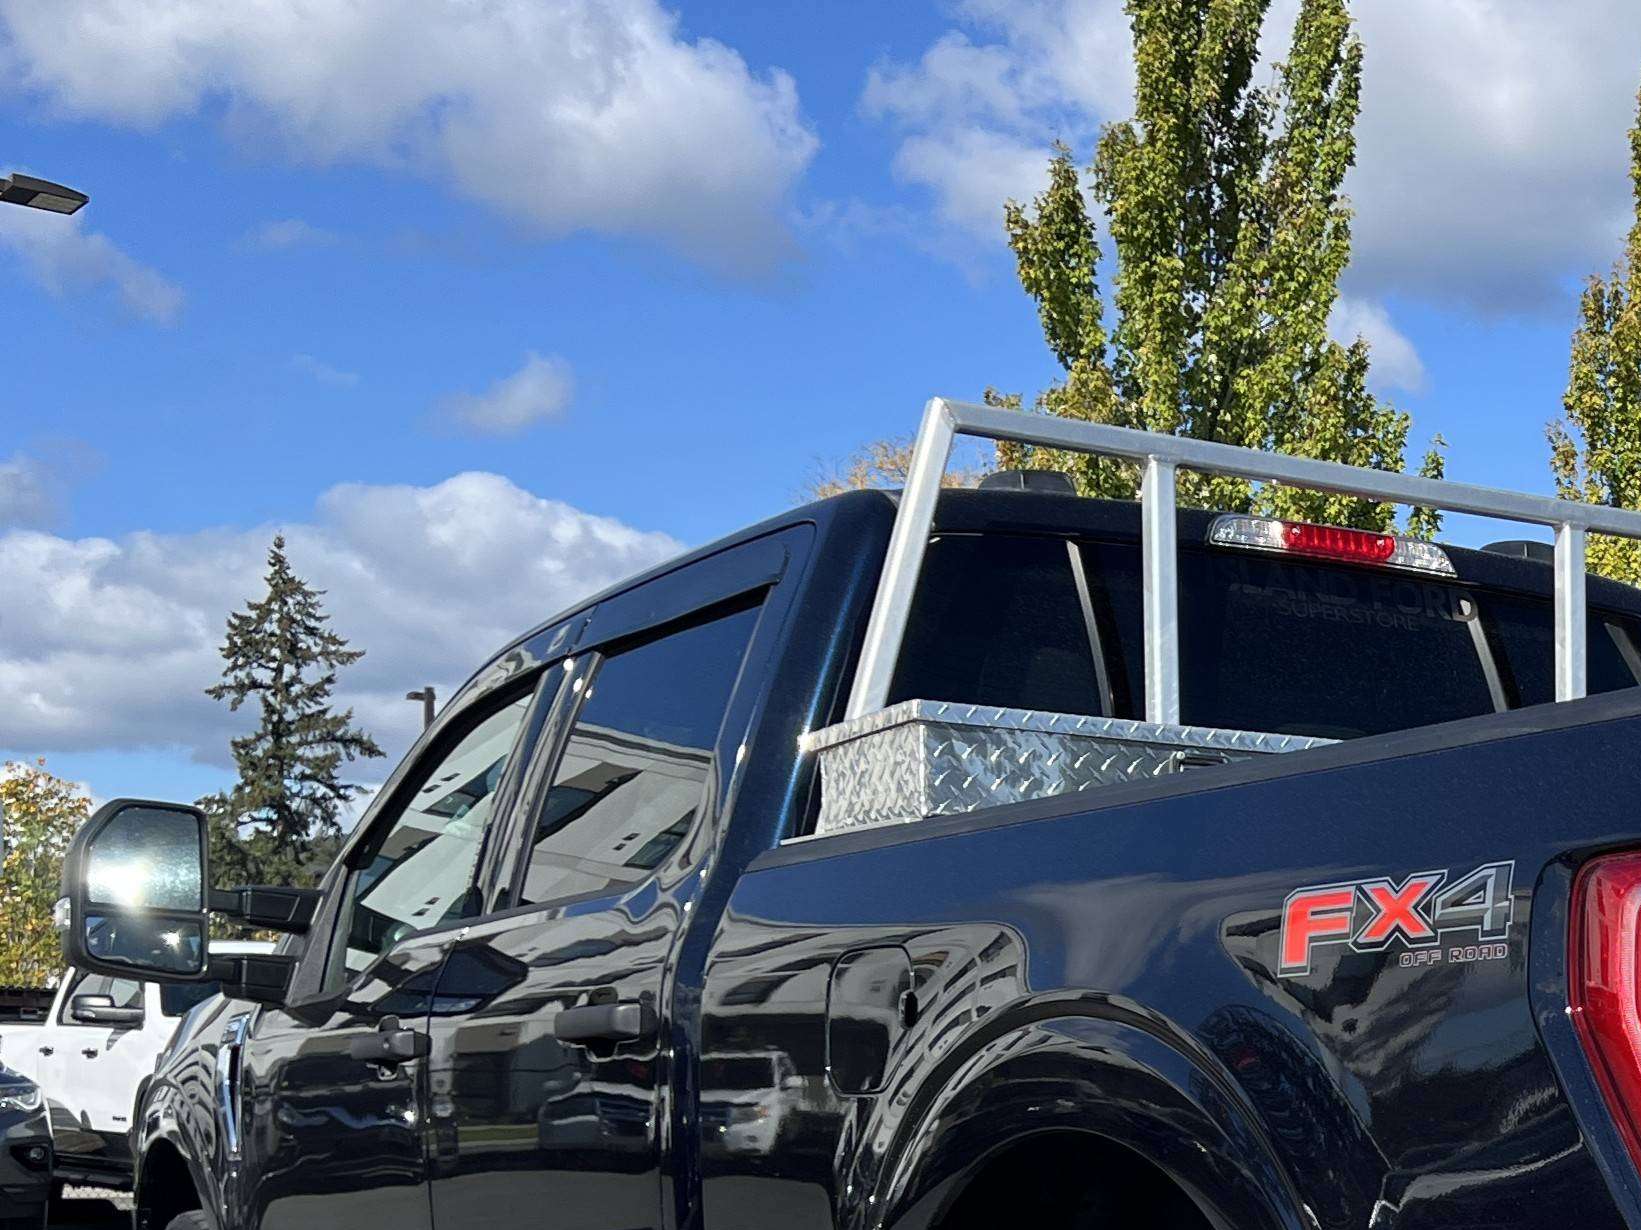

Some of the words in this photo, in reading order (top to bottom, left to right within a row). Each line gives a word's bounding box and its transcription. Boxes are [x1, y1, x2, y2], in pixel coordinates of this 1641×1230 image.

[1372, 576, 1479, 622] FORD
[1277, 859, 1516, 978] FX4
[1399, 949, 1442, 968] OFF
[1448, 943, 1508, 963] ROAD
